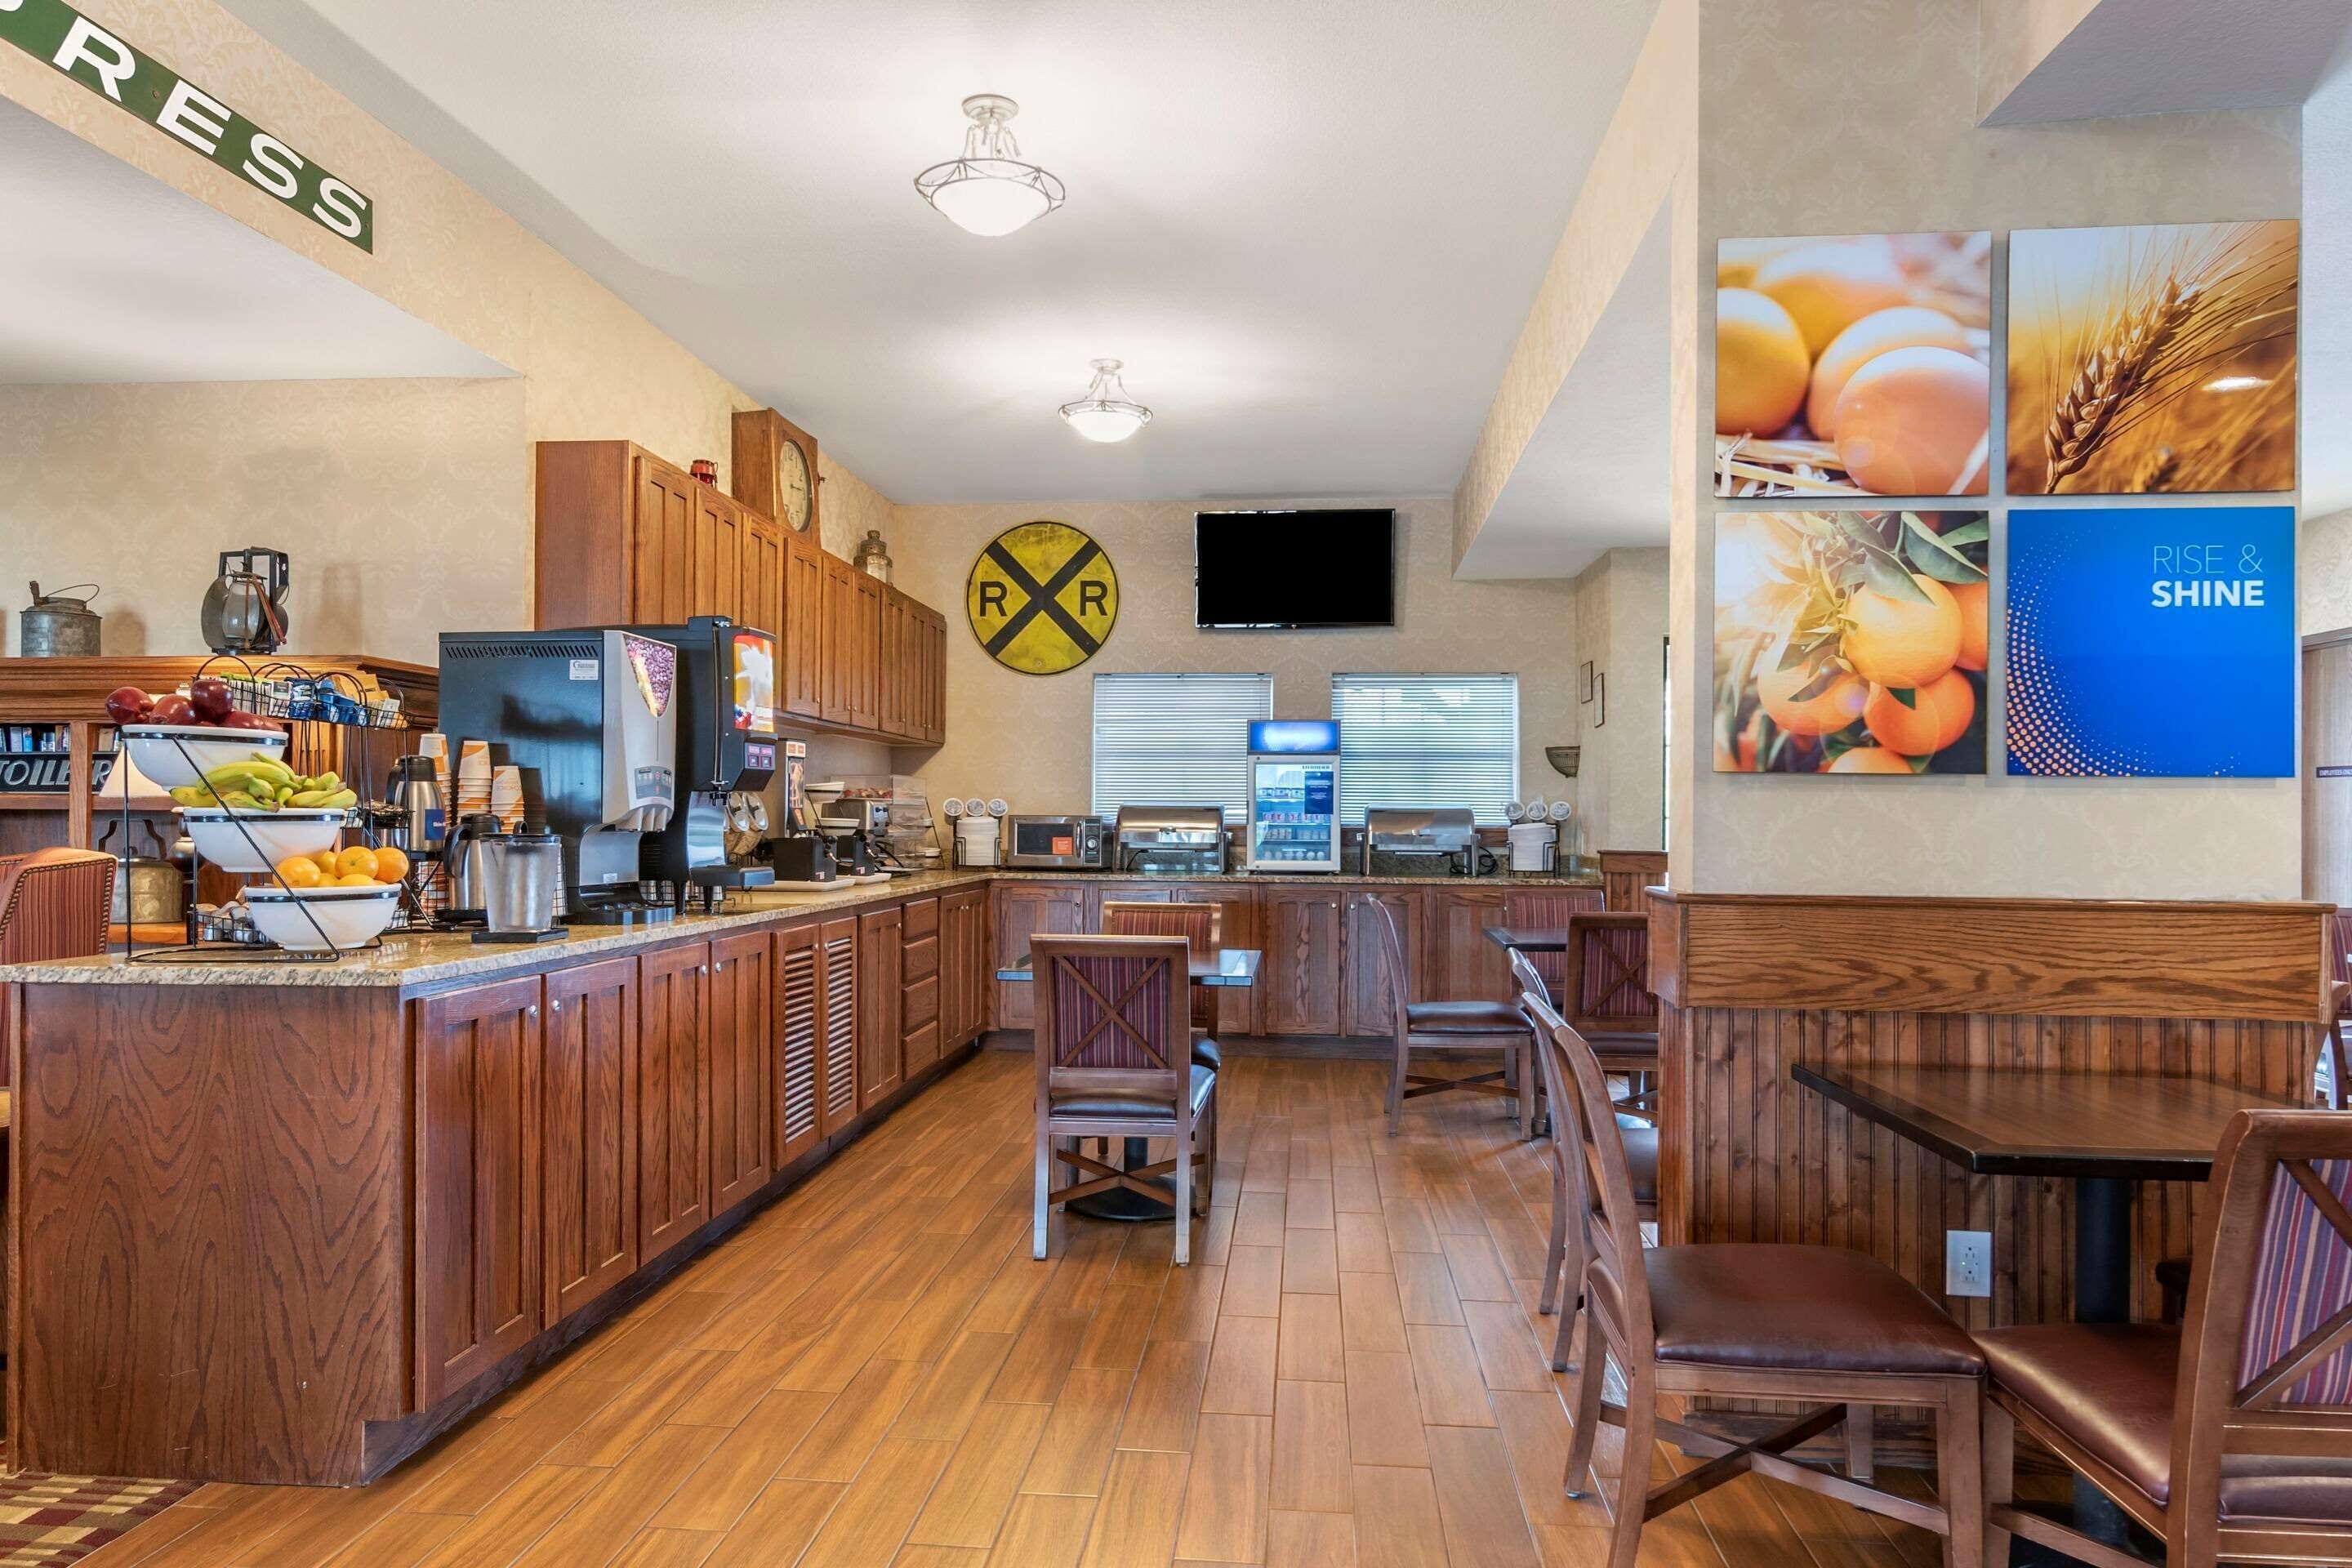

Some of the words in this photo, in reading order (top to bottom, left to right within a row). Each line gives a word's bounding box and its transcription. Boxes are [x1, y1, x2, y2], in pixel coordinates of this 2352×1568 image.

[0, 0, 368, 238] RESS
[2154, 545, 2225, 574] RISE
[2238, 544, 2263, 574] &
[979, 581, 1008, 617] R
[1080, 580, 1108, 616] R
[2151, 580, 2265, 608] SHINE
